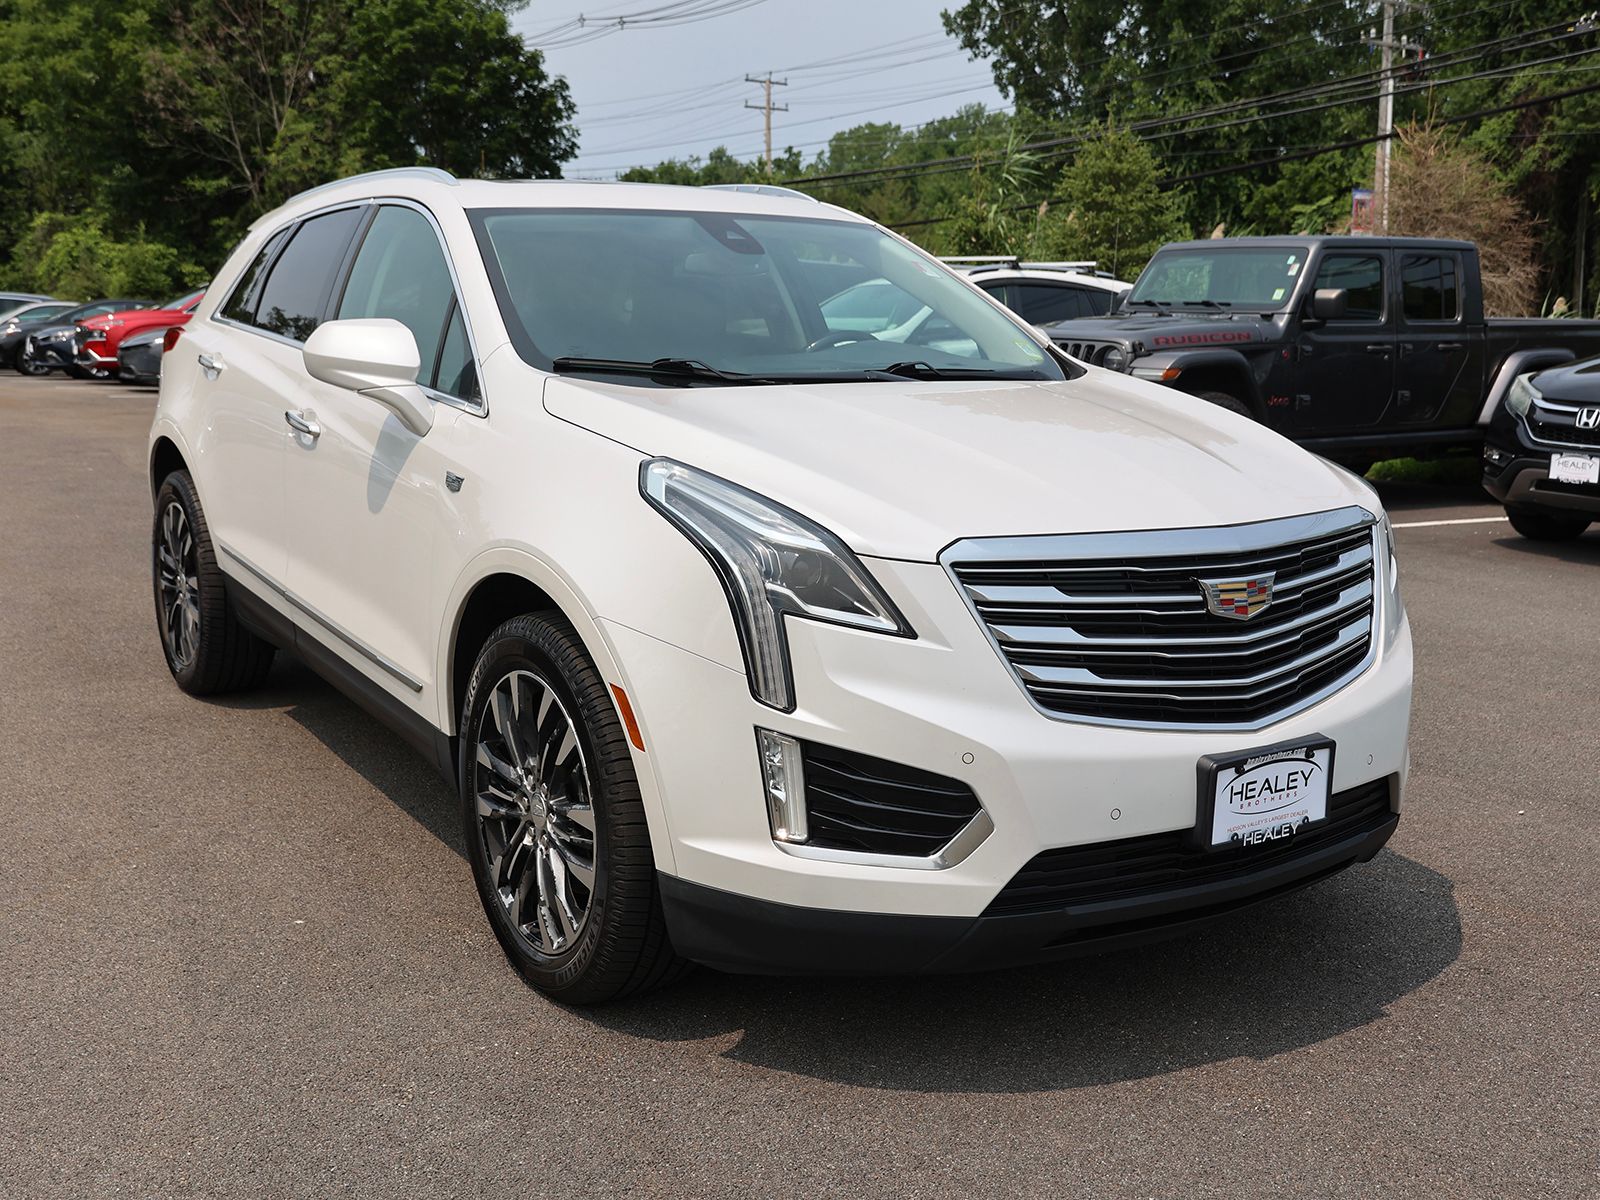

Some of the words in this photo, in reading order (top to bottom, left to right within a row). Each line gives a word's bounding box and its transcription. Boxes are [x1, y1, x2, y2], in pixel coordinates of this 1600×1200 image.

[1152, 332, 1252, 346] RUBICON
[1268, 396, 1290, 406] Jeep
[1557, 460, 1594, 469] HEALEY
[1229, 768, 1315, 804] HEALEY
[1240, 791, 1298, 810] BROTHERS
[1227, 823, 1247, 832] HUDSON
[1268, 813, 1290, 823] LARGEST
[1290, 809, 1309, 818] DEALER
[1243, 822, 1299, 847] HEALEY
